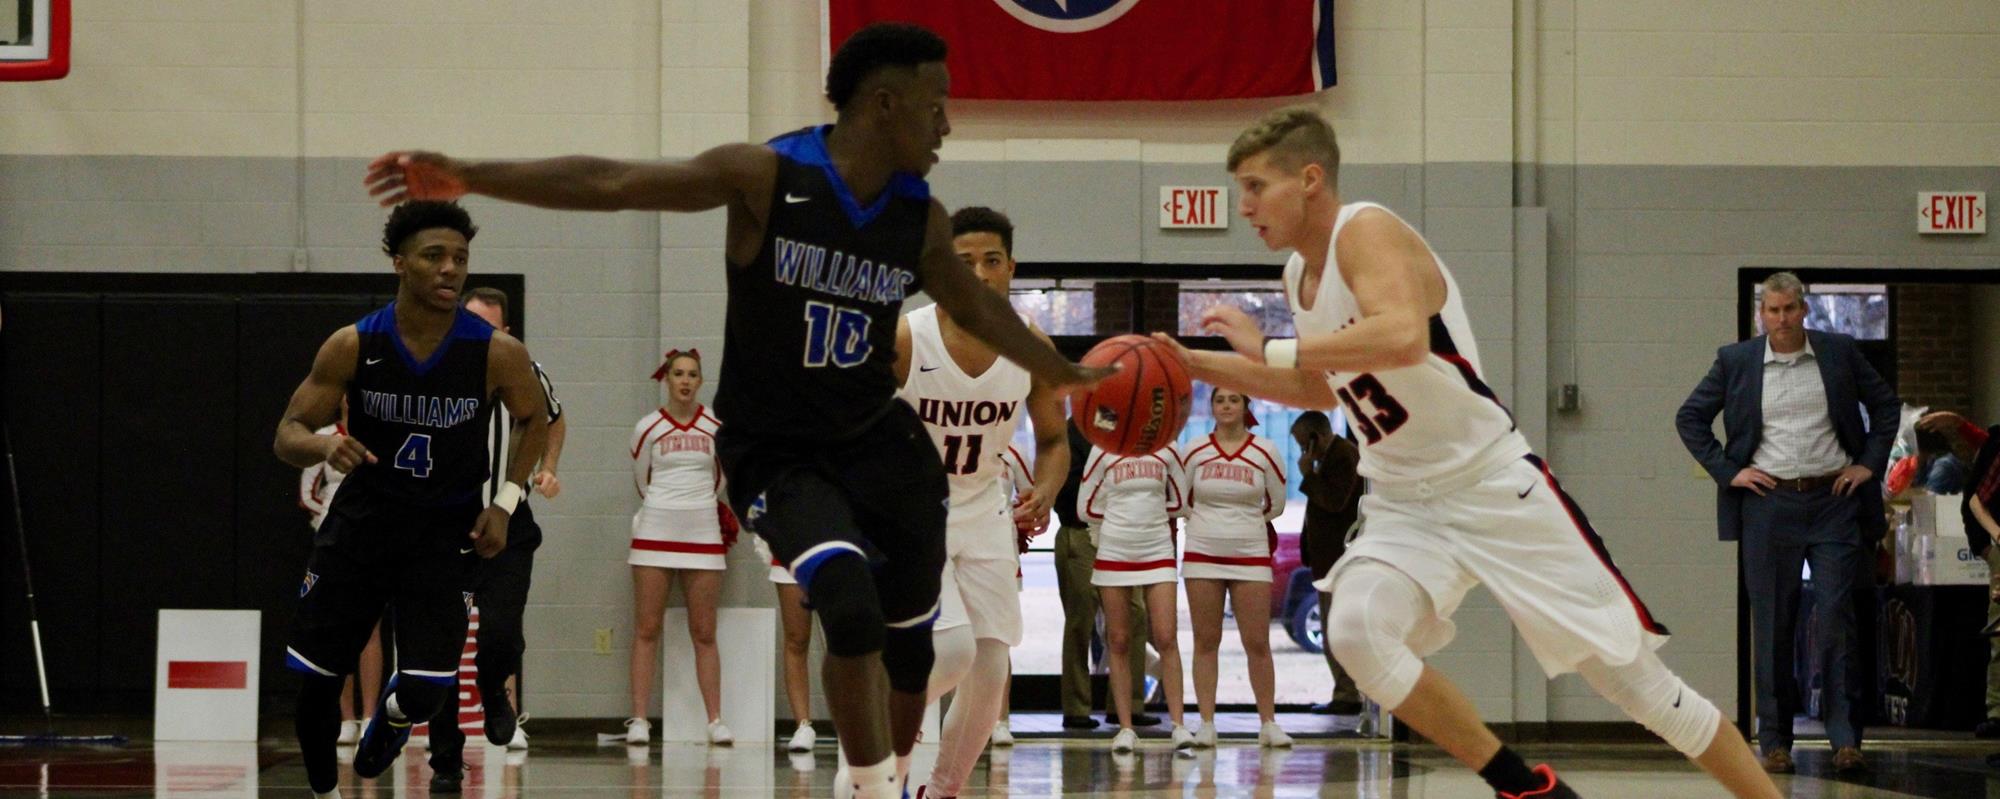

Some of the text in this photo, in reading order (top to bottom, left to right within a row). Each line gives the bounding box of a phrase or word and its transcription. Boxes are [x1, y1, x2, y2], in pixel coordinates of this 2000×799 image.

[1172, 190, 1219, 225] EXIT
[1931, 195, 1977, 229] EXIT
[775, 237, 915, 305] WILLIAMS
[804, 301, 873, 368] 10
[361, 388, 479, 428] WILLIAMS
[919, 398, 1018, 427] UNION
[1337, 372, 1409, 446] 13
[394, 433, 433, 478] 4
[943, 434, 983, 475] 11
